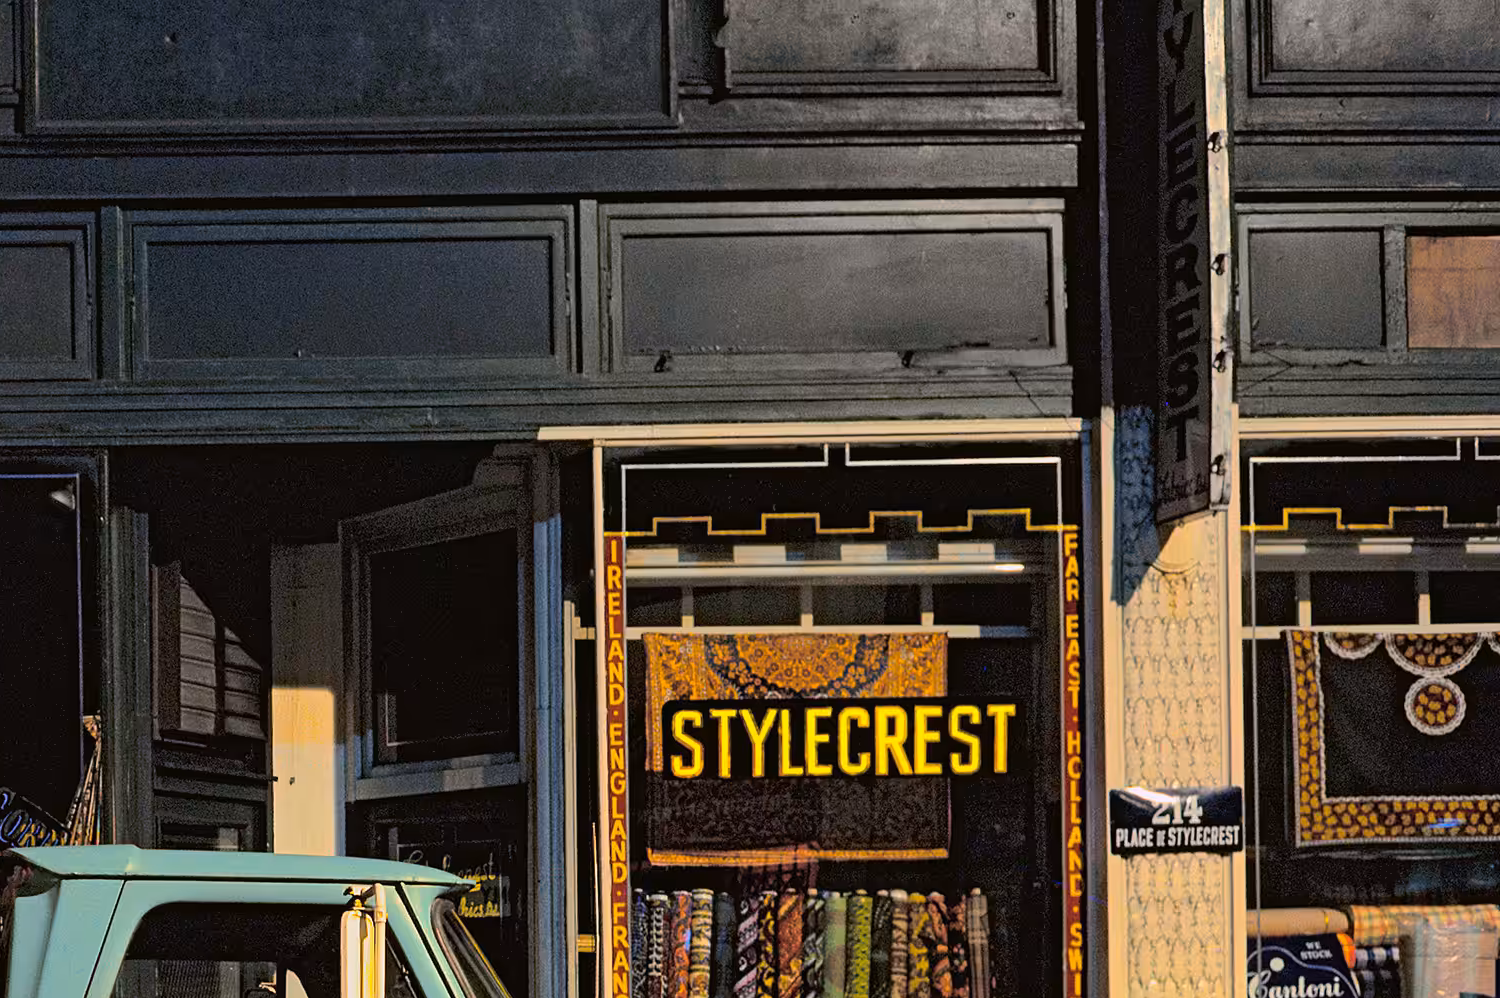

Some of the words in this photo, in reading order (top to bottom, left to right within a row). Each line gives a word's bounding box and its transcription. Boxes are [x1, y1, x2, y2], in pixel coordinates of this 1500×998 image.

[1164, 0, 1201, 462] YLECREST
[1063, 533, 1079, 601] FAR
[607, 540, 625, 706] IRELAND
[1066, 614, 1081, 709] EAST
[671, 703, 1017, 779] STYLECREST
[609, 723, 628, 884] ENGLAND
[1067, 730, 1083, 898] HOLLAND
[1115, 827, 1154, 848] PLACE
[1167, 825, 1240, 847] STYLECREST
[1151, 795, 1203, 825] 214
